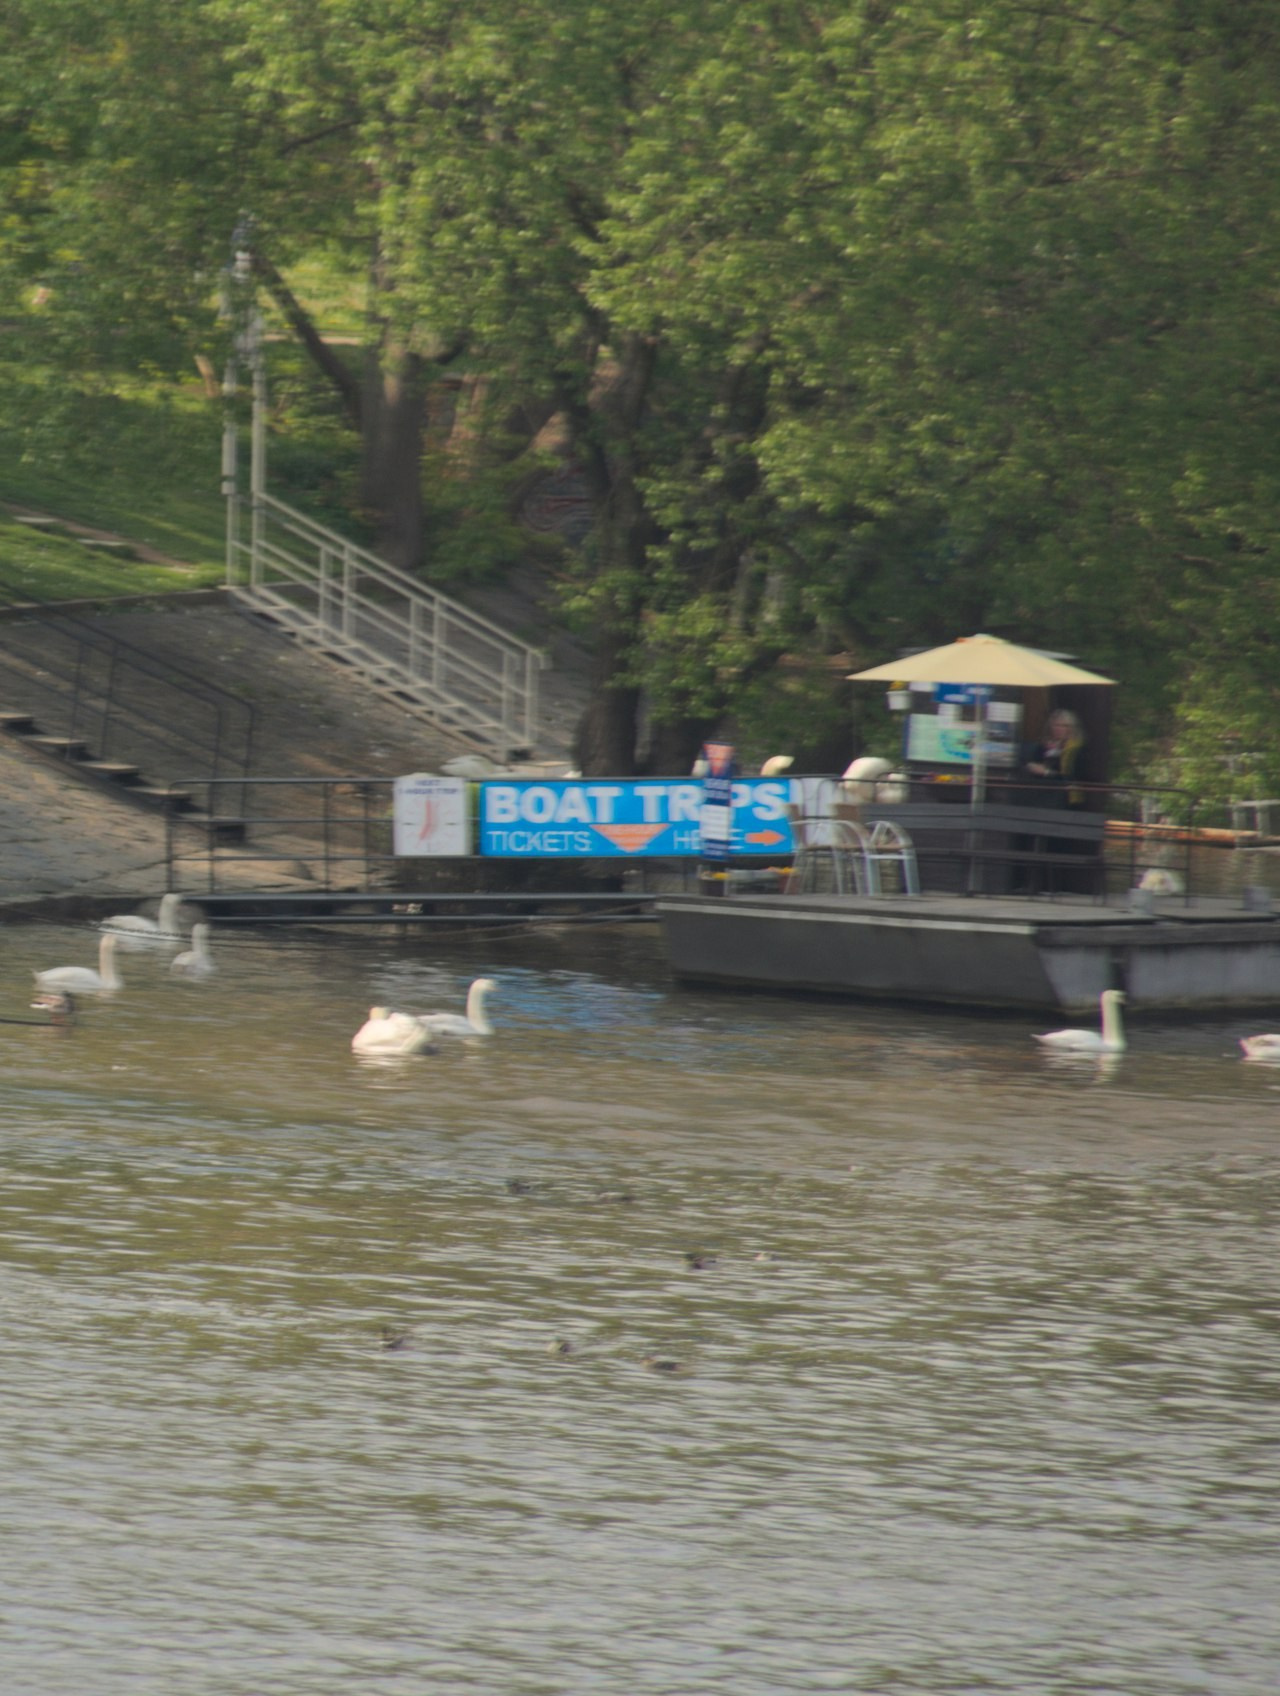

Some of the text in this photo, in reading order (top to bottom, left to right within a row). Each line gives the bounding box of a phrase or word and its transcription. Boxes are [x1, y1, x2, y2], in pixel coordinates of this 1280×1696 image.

[485, 786, 622, 823] BOAT
[634, 783, 787, 822] TRPS
[486, 830, 593, 852] TICKETS
[673, 828, 745, 850] HEE
